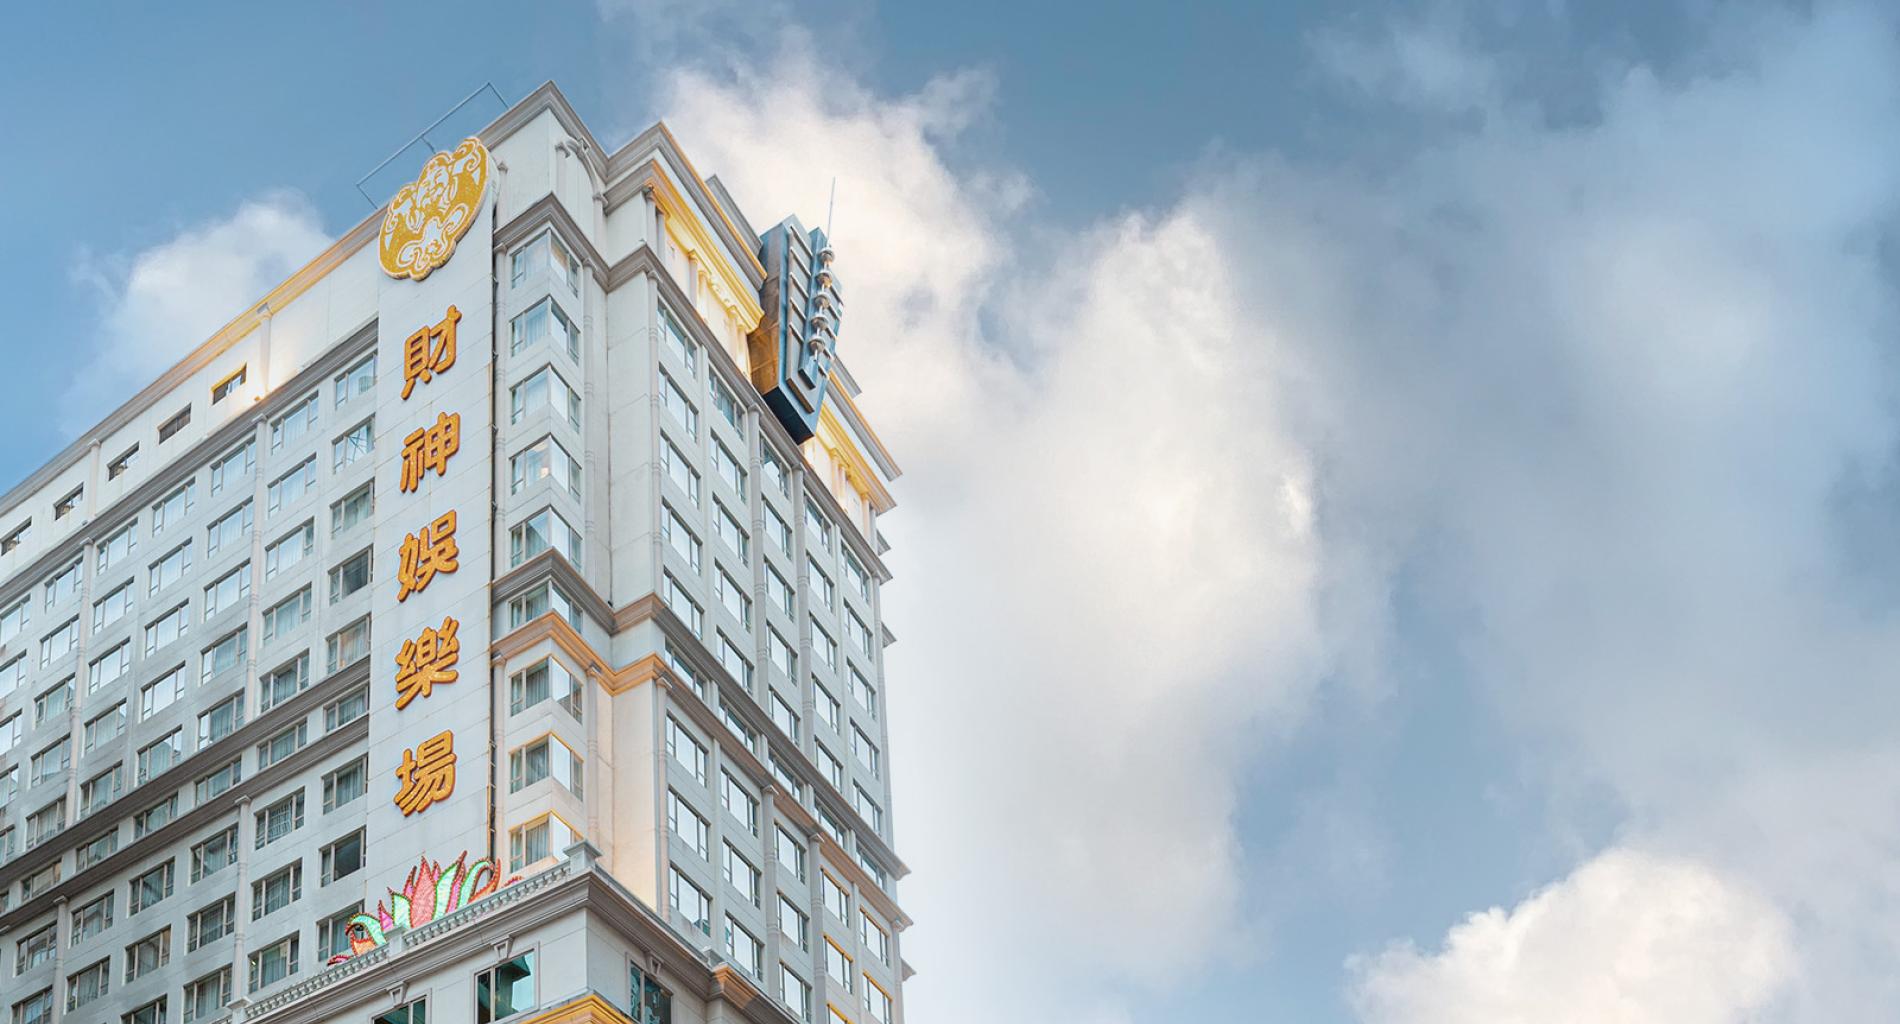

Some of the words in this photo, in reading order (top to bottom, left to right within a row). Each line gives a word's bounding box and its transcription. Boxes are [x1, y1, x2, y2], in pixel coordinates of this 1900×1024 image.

[394, 304, 463, 816] 財神娛樂場
